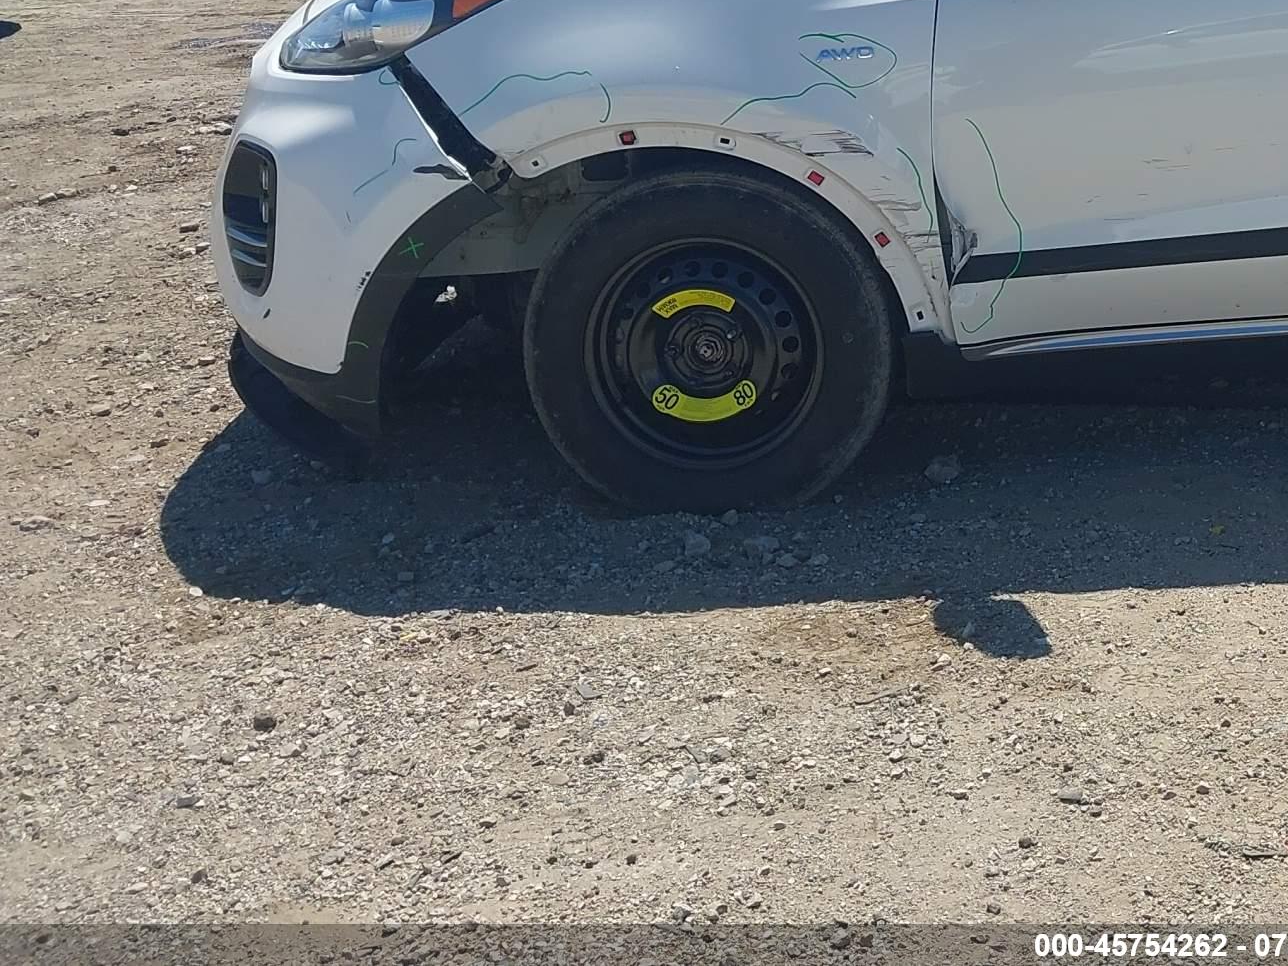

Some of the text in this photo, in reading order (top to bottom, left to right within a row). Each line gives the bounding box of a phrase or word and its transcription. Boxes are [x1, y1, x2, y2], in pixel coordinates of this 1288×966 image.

[816, 46, 875, 63] AWD
[654, 386, 680, 410] 50
[733, 382, 754, 406] 80
